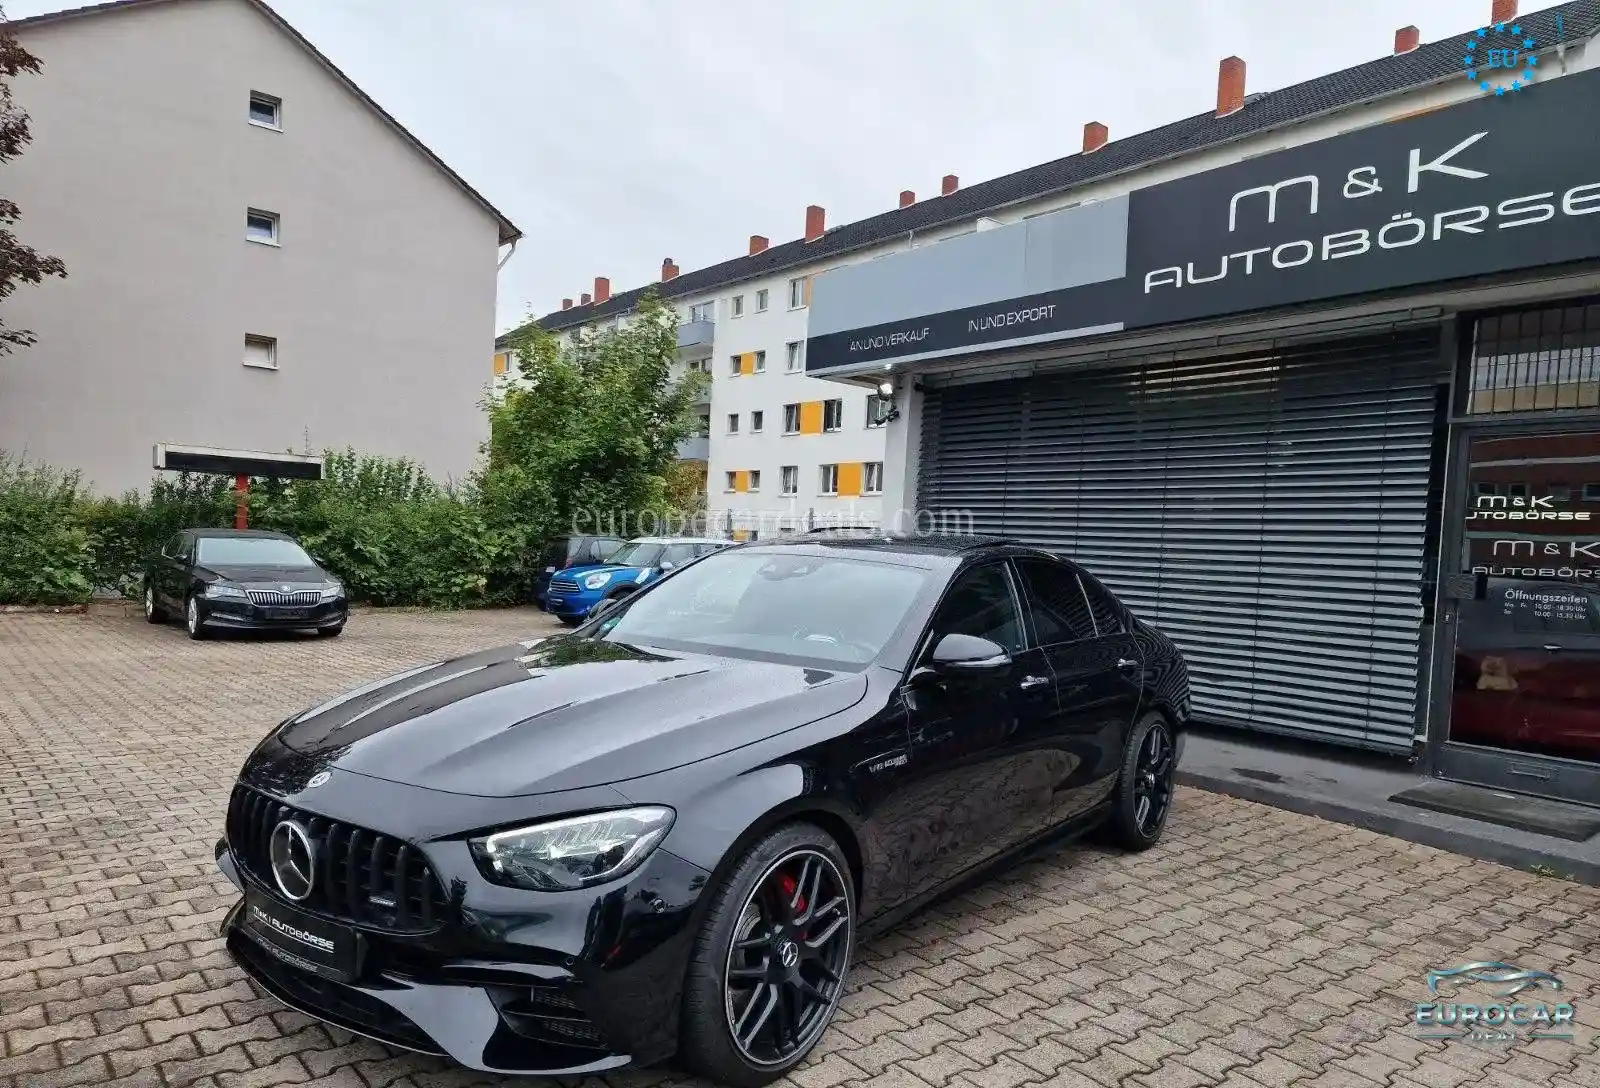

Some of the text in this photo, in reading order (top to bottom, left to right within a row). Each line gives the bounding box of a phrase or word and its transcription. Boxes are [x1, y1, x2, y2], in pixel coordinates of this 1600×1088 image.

[1342, 165, 1383, 199] &
[1407, 130, 1490, 195] K
[1144, 182, 1600, 294] AUTOBÖRSE
[968, 304, 1057, 332] IN UND EXPORT
[850, 327, 930, 351] AN UND VERKAUF
[1512, 497, 1525, 506] &
[1530, 495, 1554, 508] K
[1544, 542, 1560, 555] &
[1570, 541, 1600, 558] K
[1505, 587, 1588, 604] Öffnungszeiten
[272, 918, 335, 950] AUTOBÖRSE
